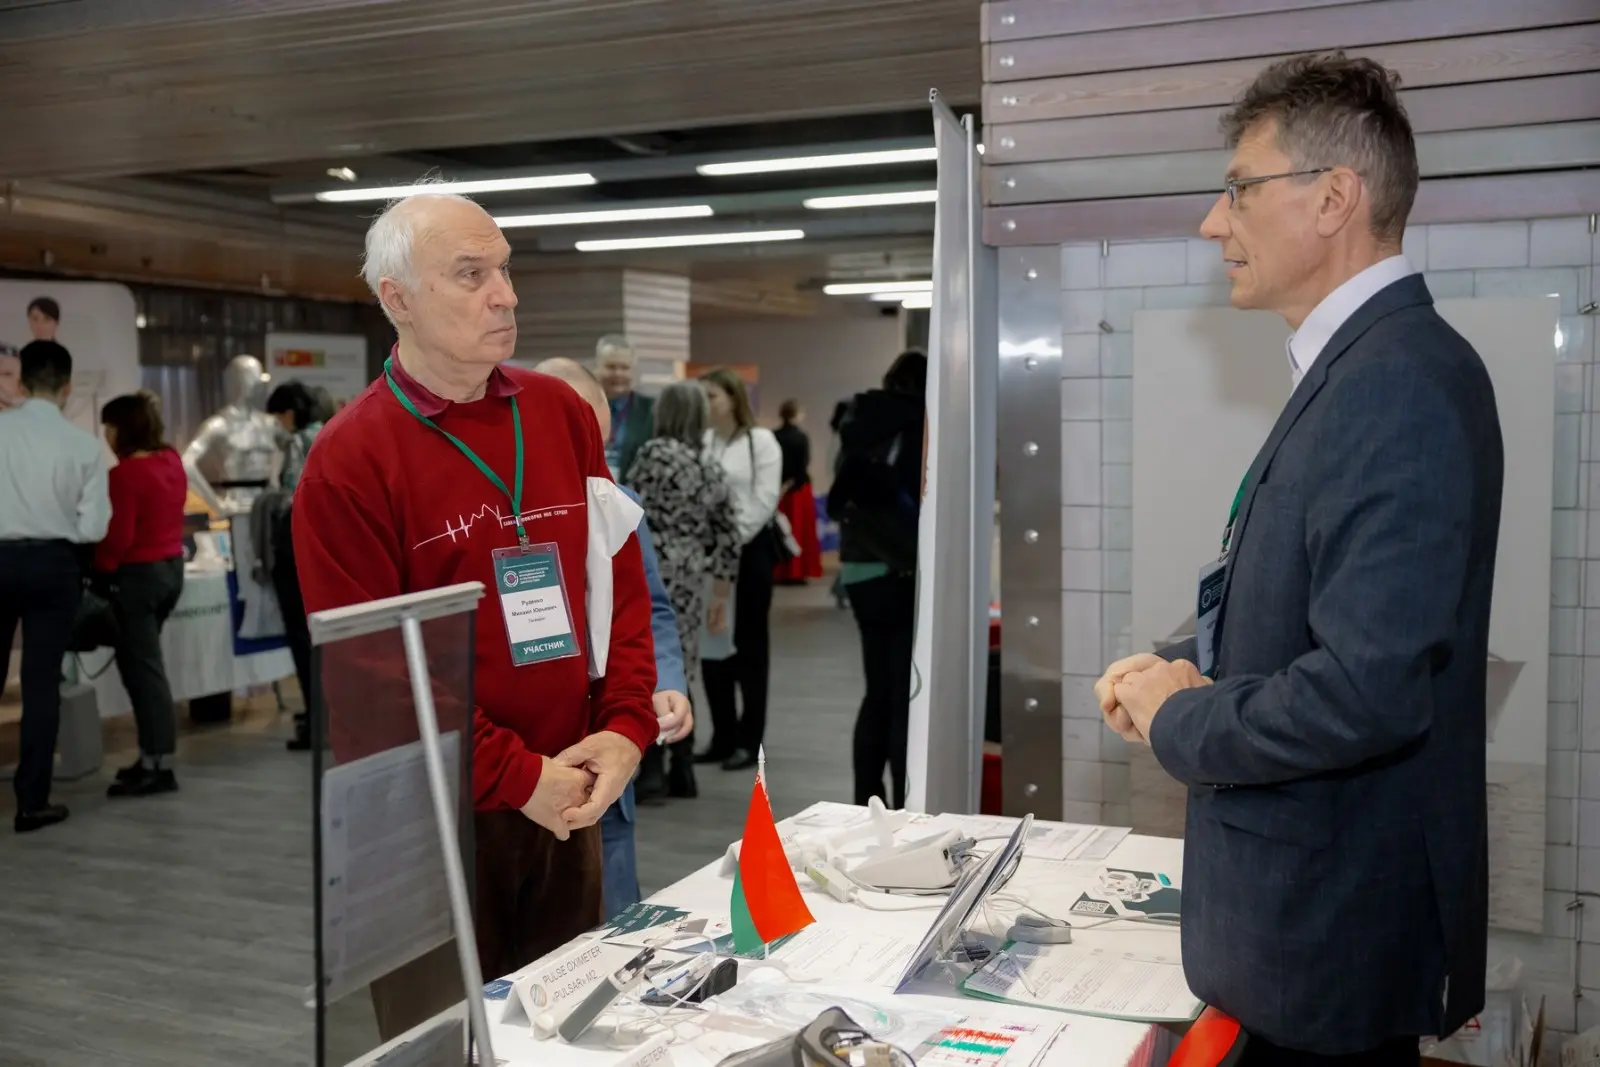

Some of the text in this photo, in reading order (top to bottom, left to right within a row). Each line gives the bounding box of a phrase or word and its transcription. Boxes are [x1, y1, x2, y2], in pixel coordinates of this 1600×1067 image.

[523, 640, 565, 655] УЧАСТНИК
[542, 945, 602, 985] PULSE OXIMETER
